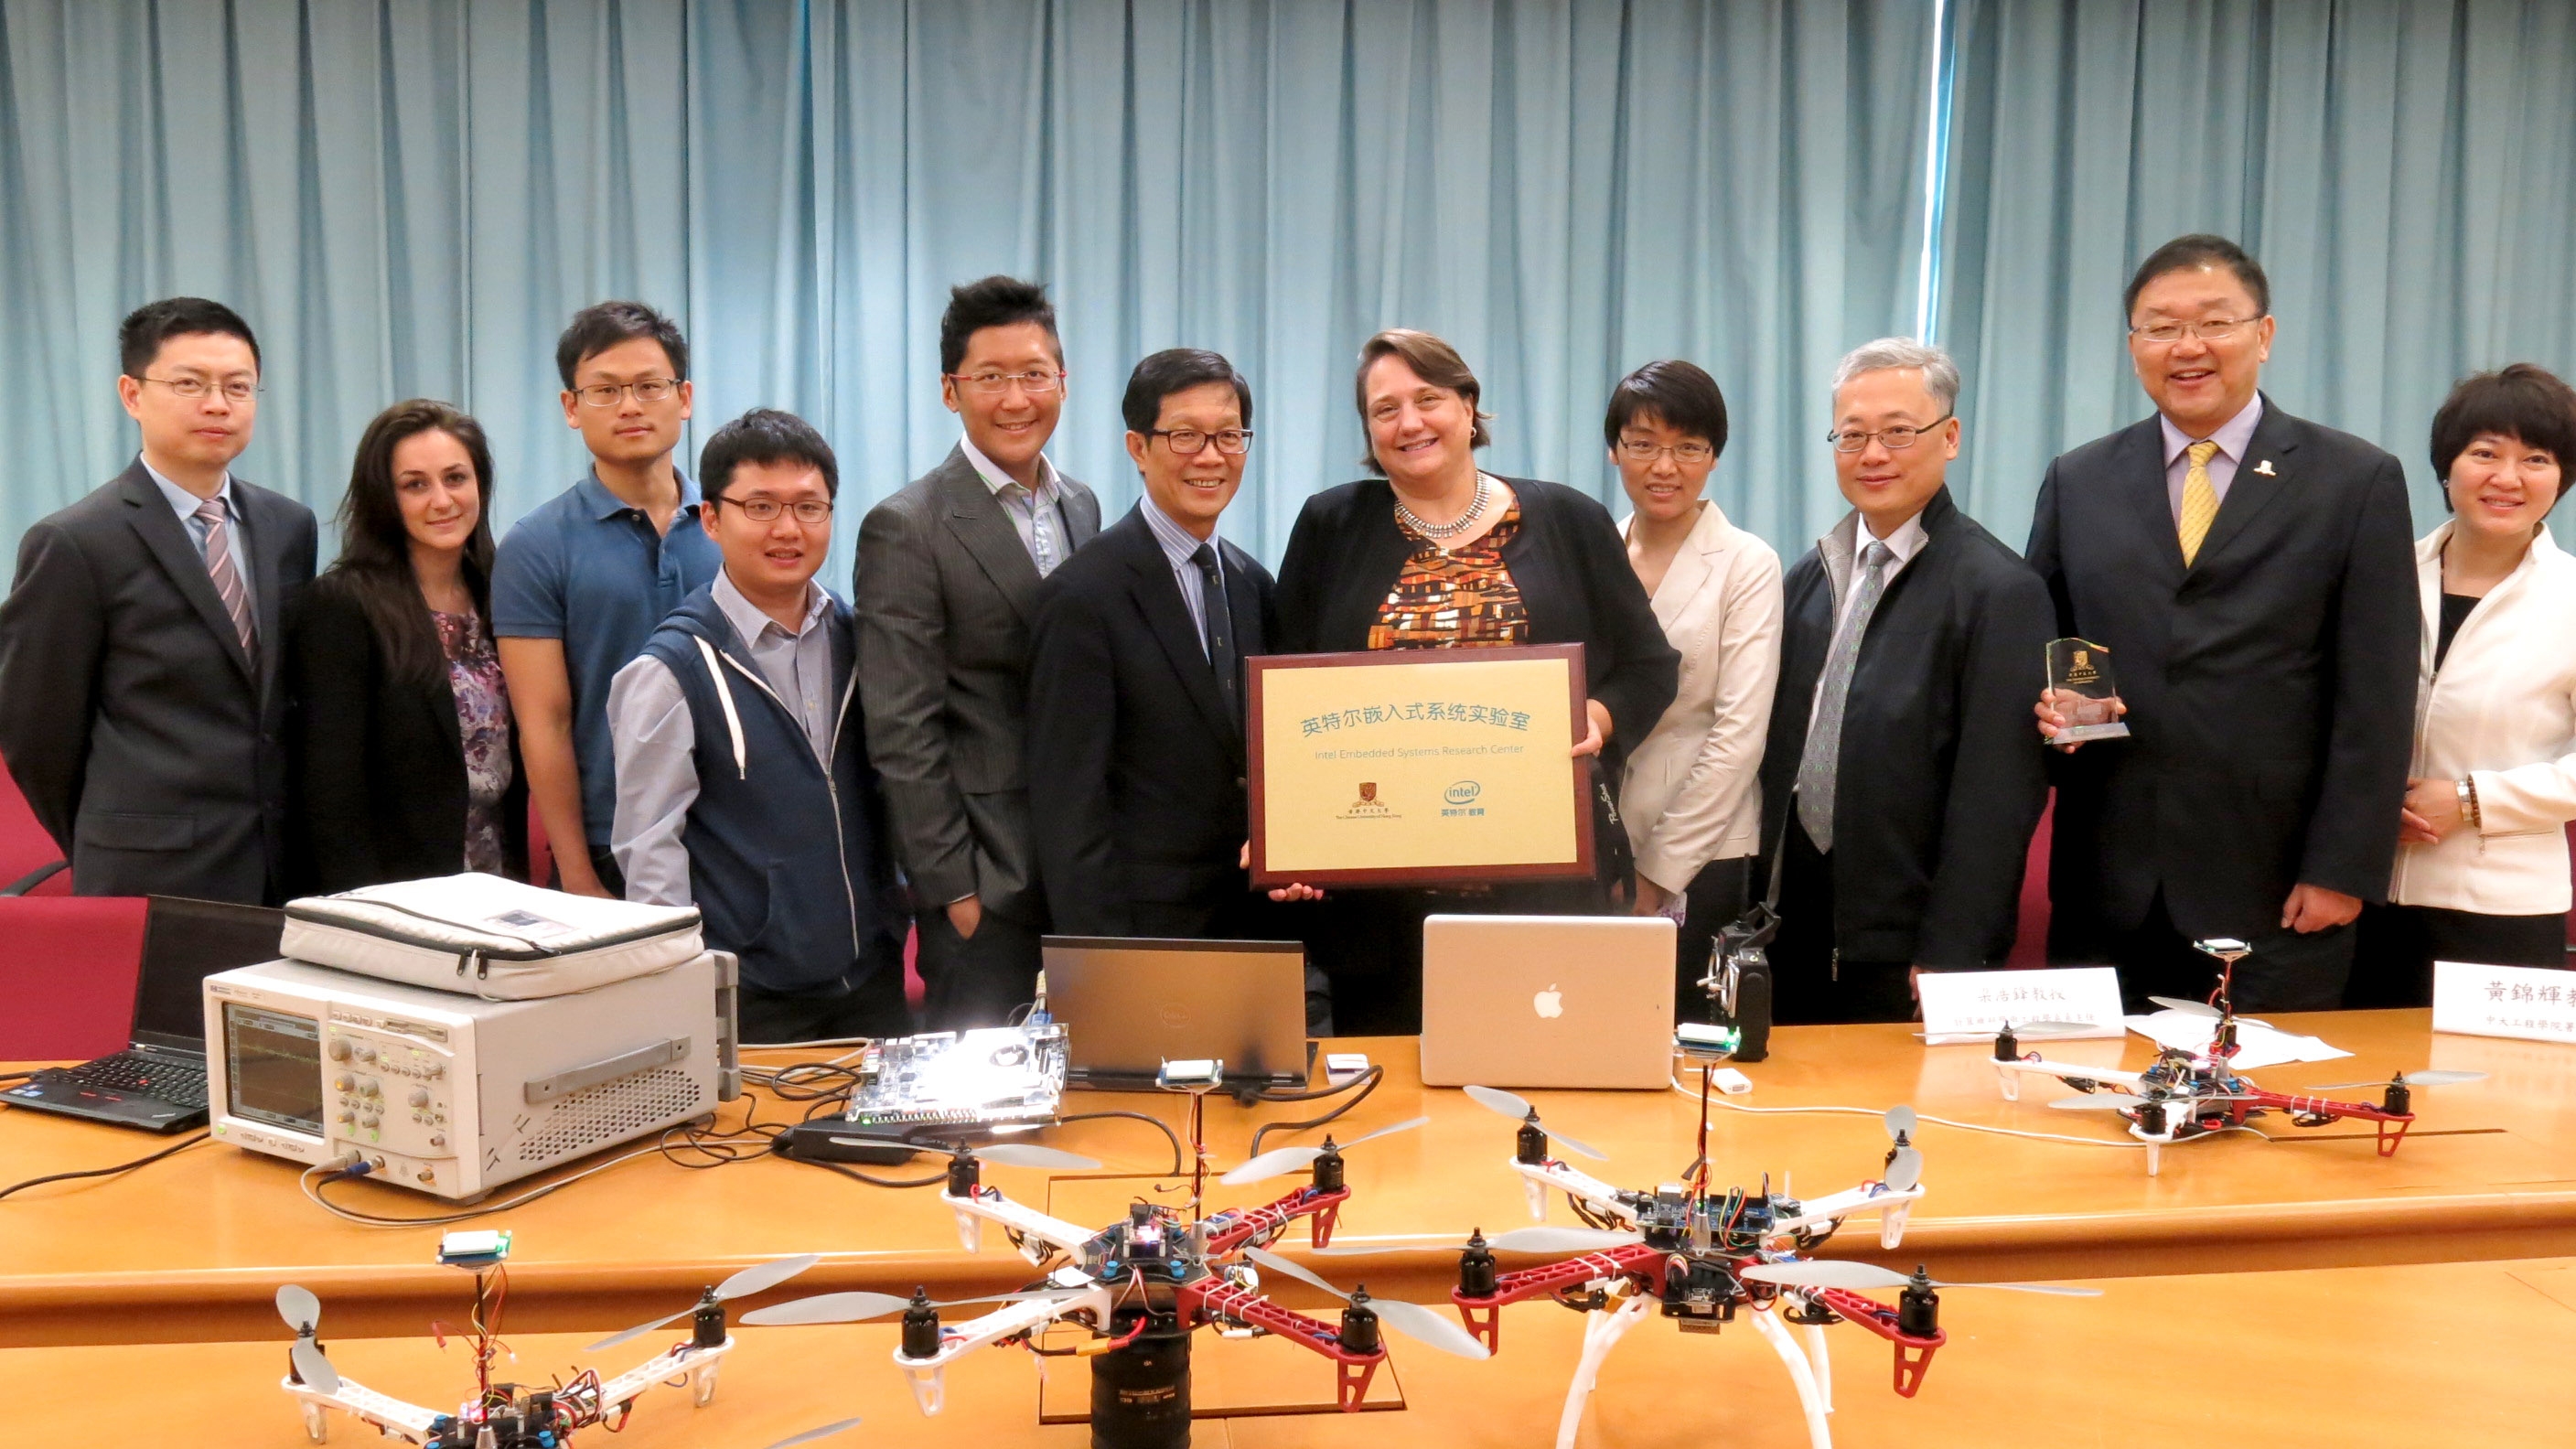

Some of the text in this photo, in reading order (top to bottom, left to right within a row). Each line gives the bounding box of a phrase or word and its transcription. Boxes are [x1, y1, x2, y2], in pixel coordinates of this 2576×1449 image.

[1300, 702, 1530, 737] 英特尔嵌入式系统实验室
[1315, 744, 1524, 760] Intel Embedded Systems Research Center
[1448, 784, 1476, 798] intel
